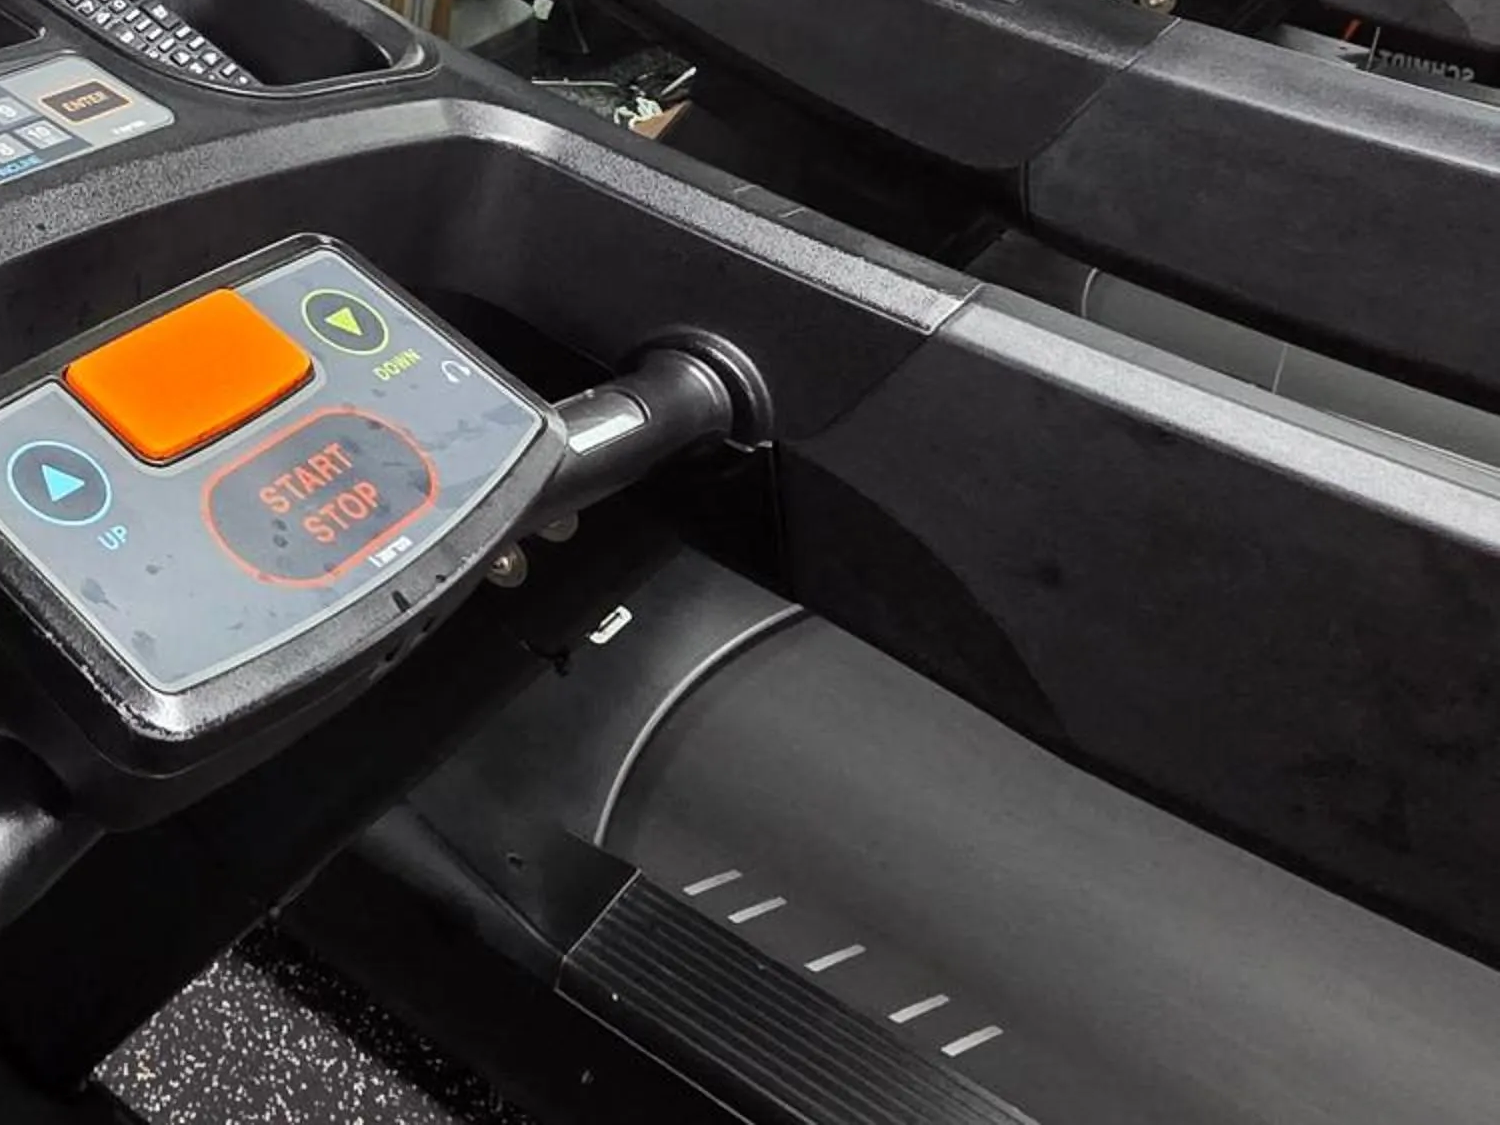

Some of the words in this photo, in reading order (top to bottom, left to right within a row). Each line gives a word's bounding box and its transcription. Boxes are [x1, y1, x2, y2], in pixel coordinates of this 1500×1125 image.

[61, 90, 108, 112] ENTER
[27, 125, 52, 141] 10
[373, 348, 422, 382] DOWN
[258, 441, 355, 515] START
[303, 480, 380, 545] STOP
[98, 524, 130, 552] UP
